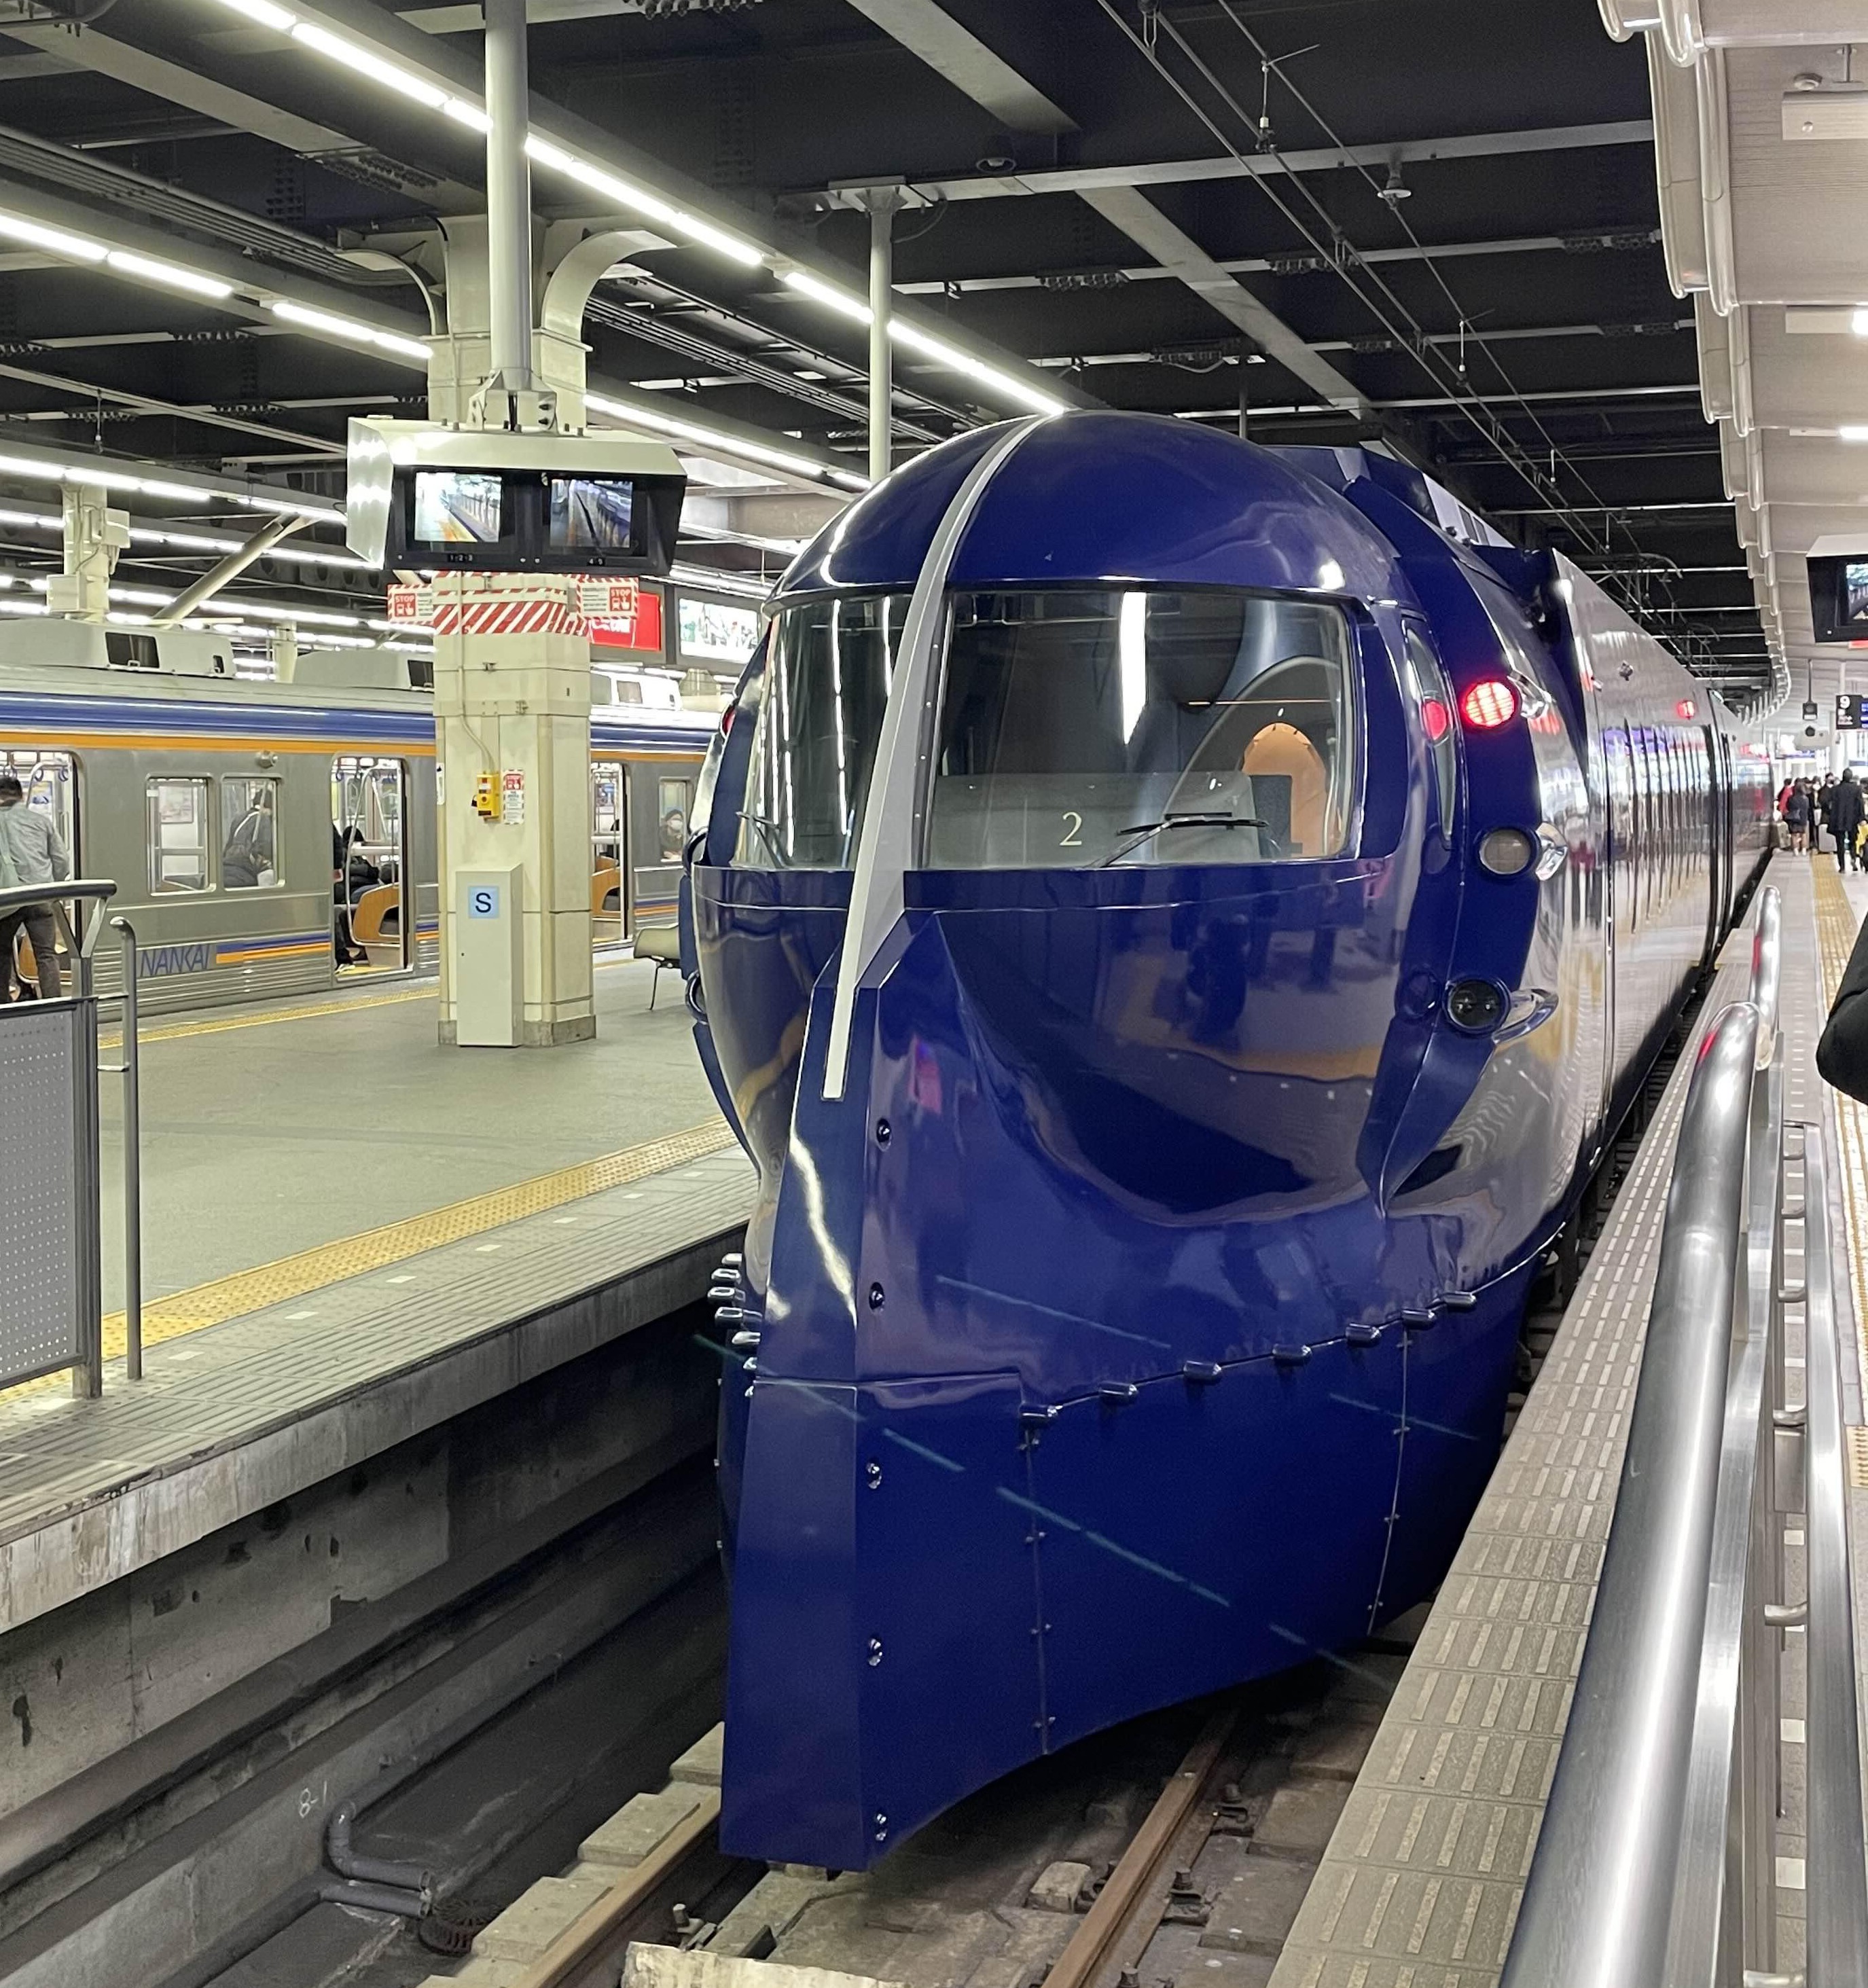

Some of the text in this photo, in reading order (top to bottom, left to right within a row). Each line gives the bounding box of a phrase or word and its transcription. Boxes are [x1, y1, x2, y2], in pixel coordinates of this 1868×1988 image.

[611, 589, 630, 597] STOP
[1839, 695, 1851, 709] 9
[1059, 812, 1082, 846] 2
[475, 892, 491, 913] S
[139, 944, 210, 977] NANKAI
